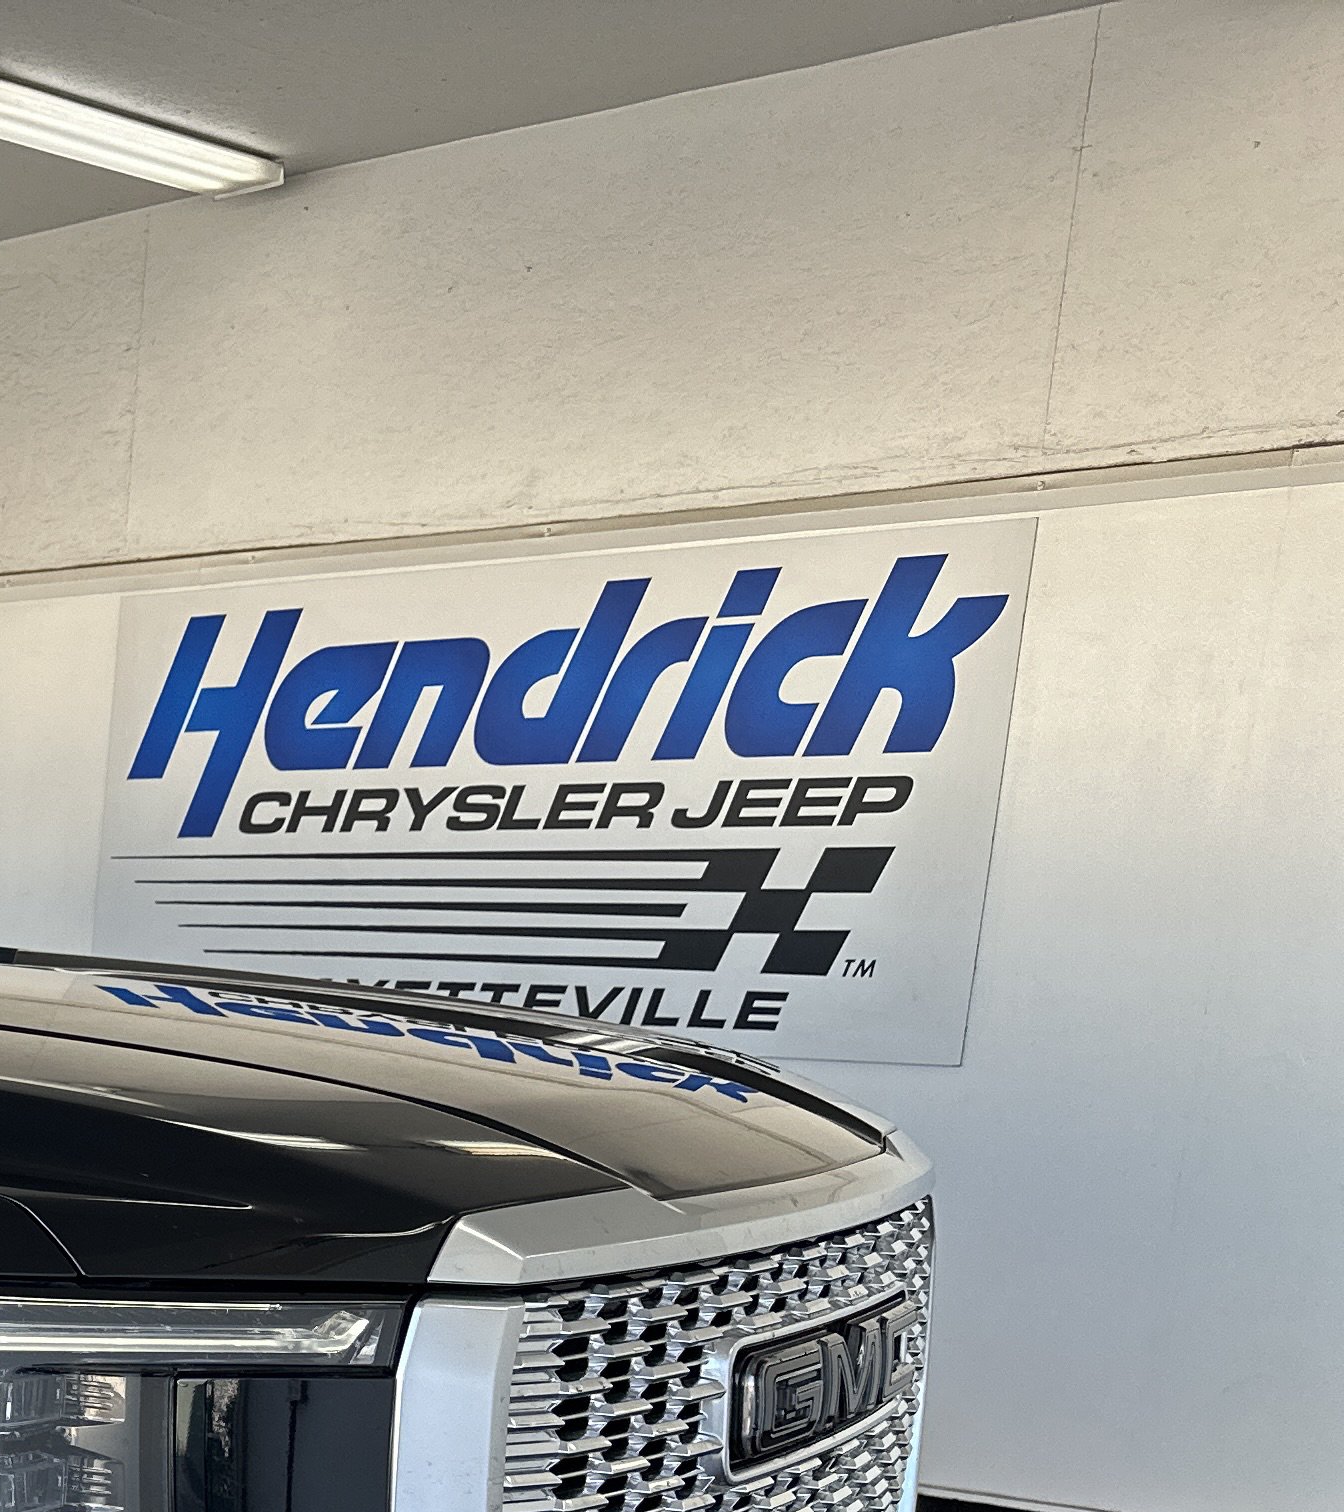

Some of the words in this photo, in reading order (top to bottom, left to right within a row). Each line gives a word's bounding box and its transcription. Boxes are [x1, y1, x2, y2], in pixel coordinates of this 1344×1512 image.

[127, 553, 1010, 838] Hendrick
[239, 781, 667, 835] CHRYSLER
[672, 775, 914, 829] JEEP
[843, 958, 876, 978] TM
[319, 978, 790, 1031] TTEVILLE
[759, 1300, 918, 1449] GMC
